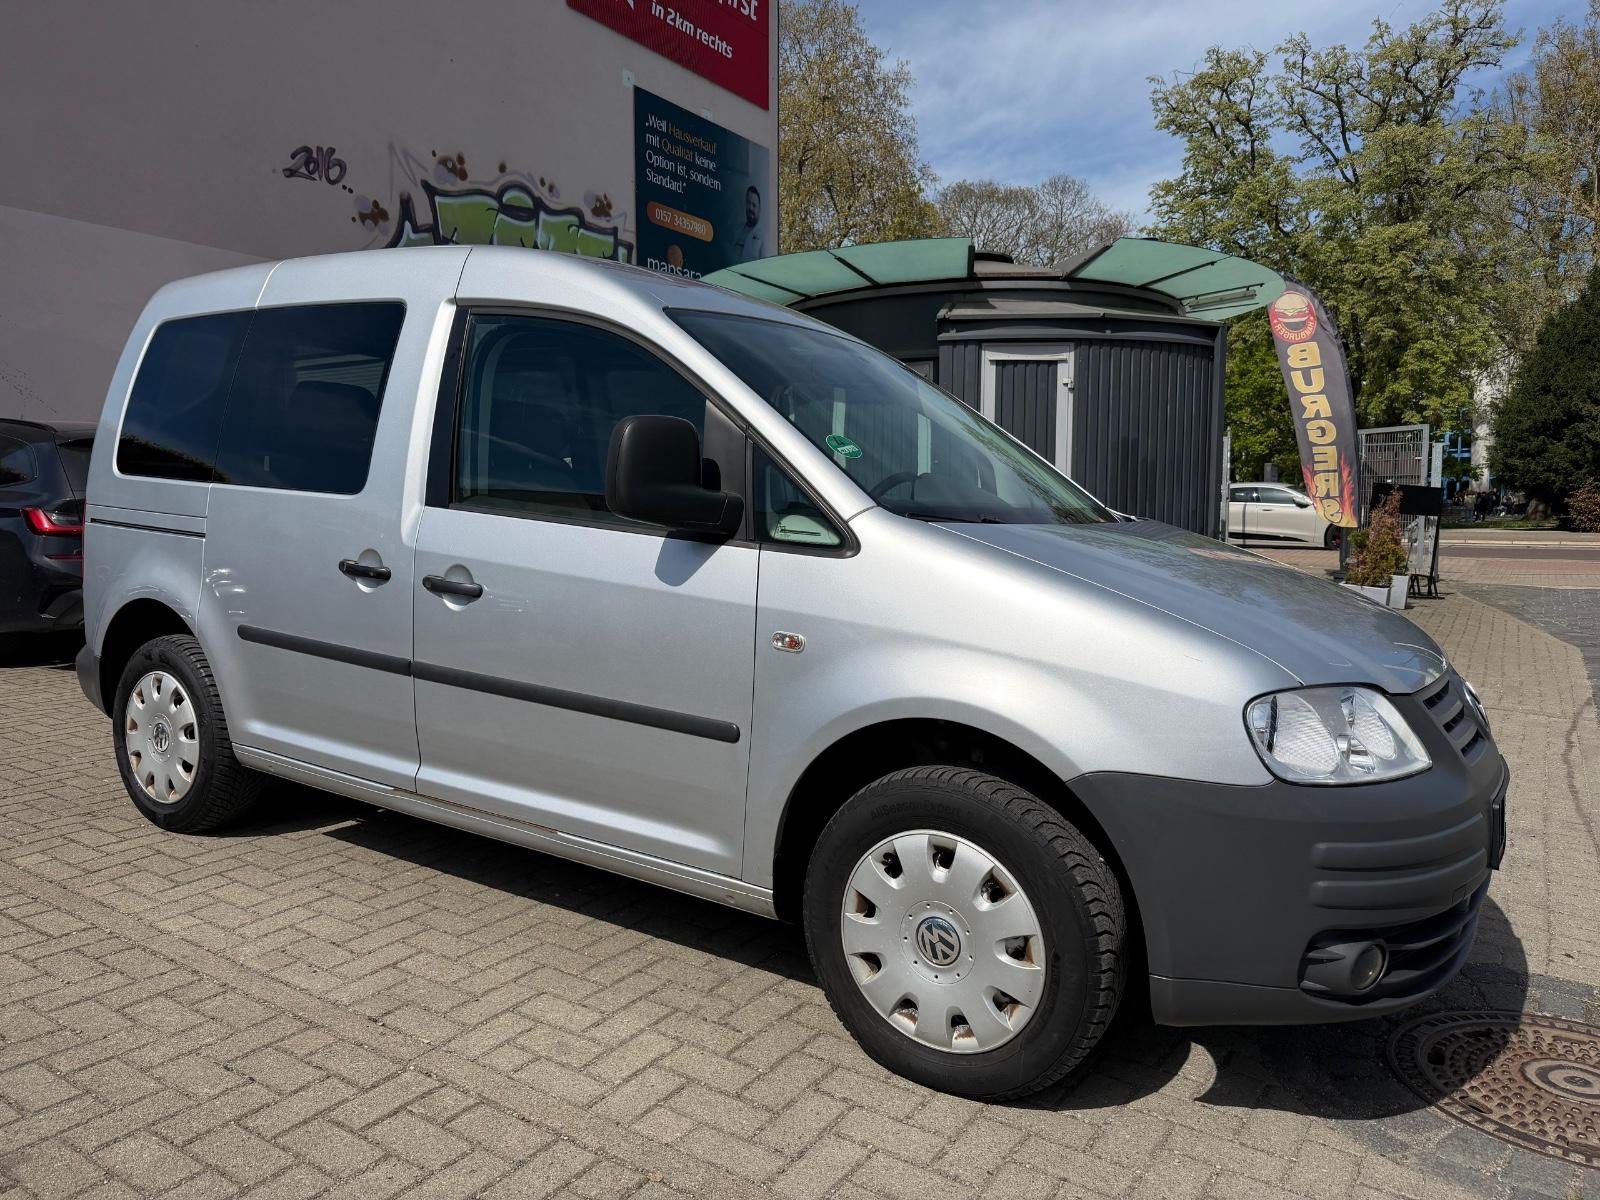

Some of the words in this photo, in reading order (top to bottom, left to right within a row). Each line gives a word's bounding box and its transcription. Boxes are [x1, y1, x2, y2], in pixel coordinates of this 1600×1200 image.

[651, 0, 664, 20] in
[696, 27, 733, 59] rechts
[645, 149, 676, 173] Option
[689, 169, 722, 192] sondern
[646, 133, 660, 149] mit
[694, 151, 717, 172] keine
[655, 208, 672, 223] 0157
